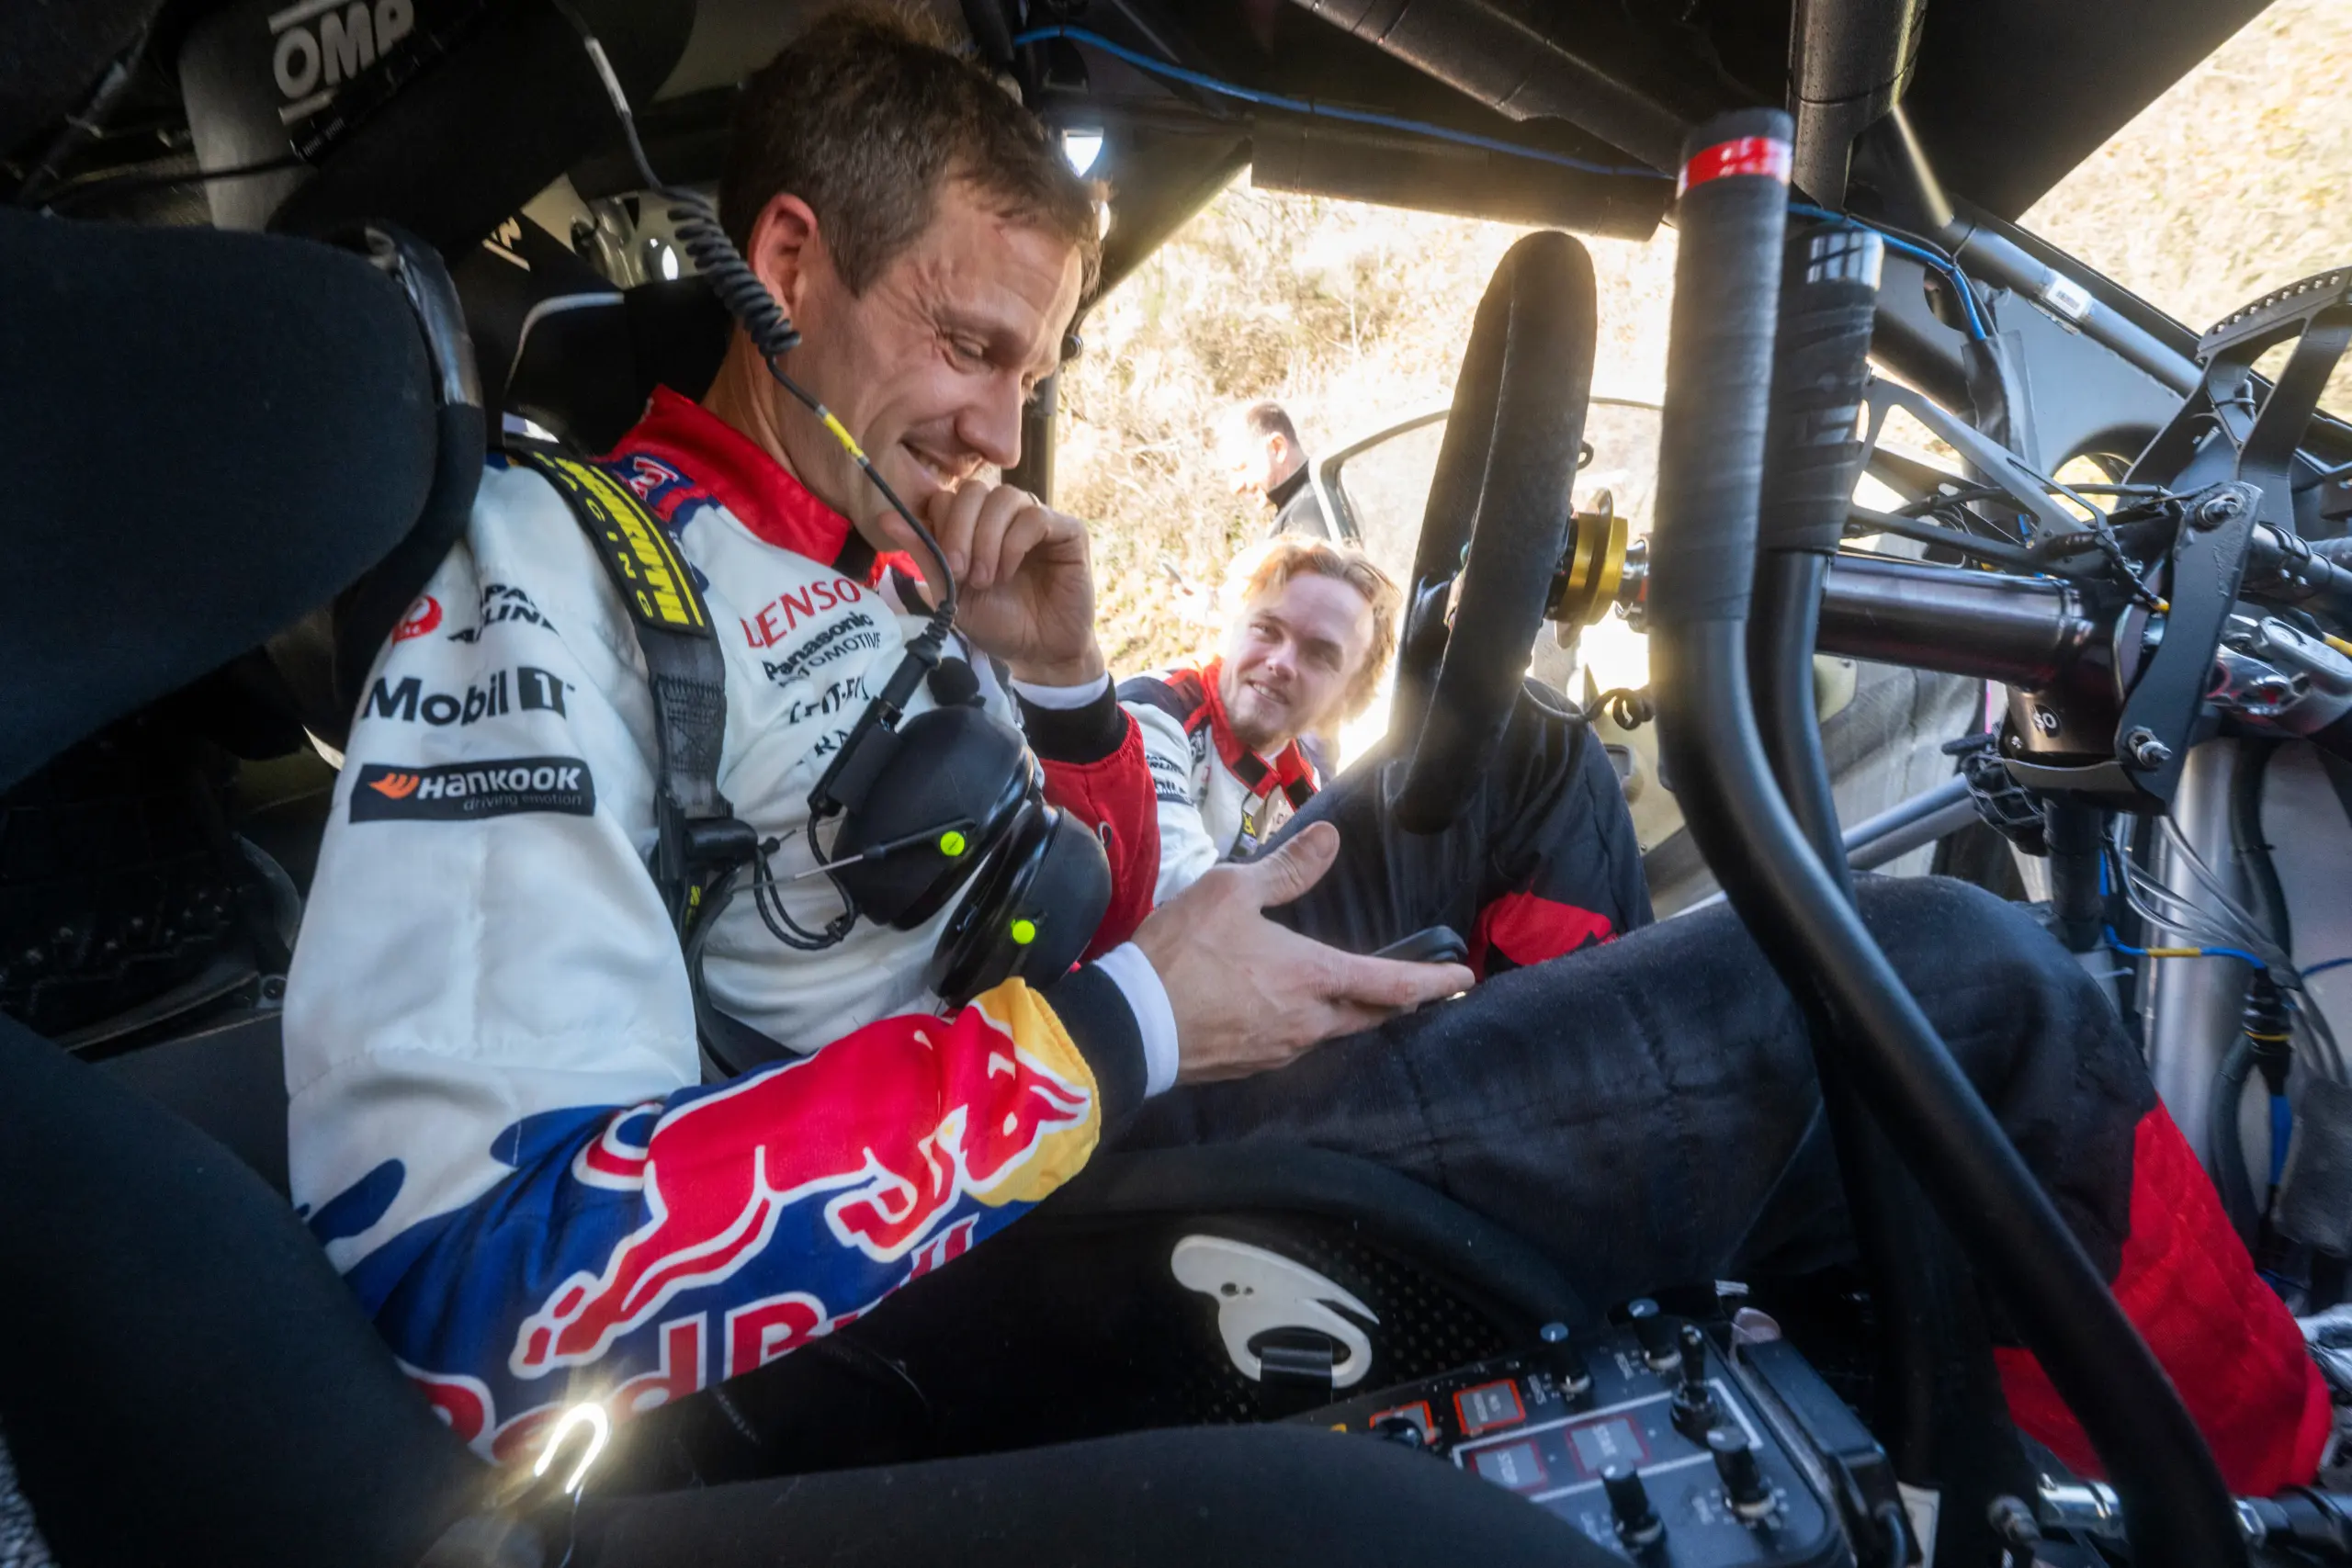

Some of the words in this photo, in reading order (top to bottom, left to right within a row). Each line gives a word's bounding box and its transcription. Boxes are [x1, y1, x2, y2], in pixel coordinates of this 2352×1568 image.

[273, 0, 414, 99] OMP
[761, 610, 875, 682] Panasonic
[361, 670, 510, 727] Mobil
[462, 794, 518, 812] driving
[521, 792, 582, 807] emotion
